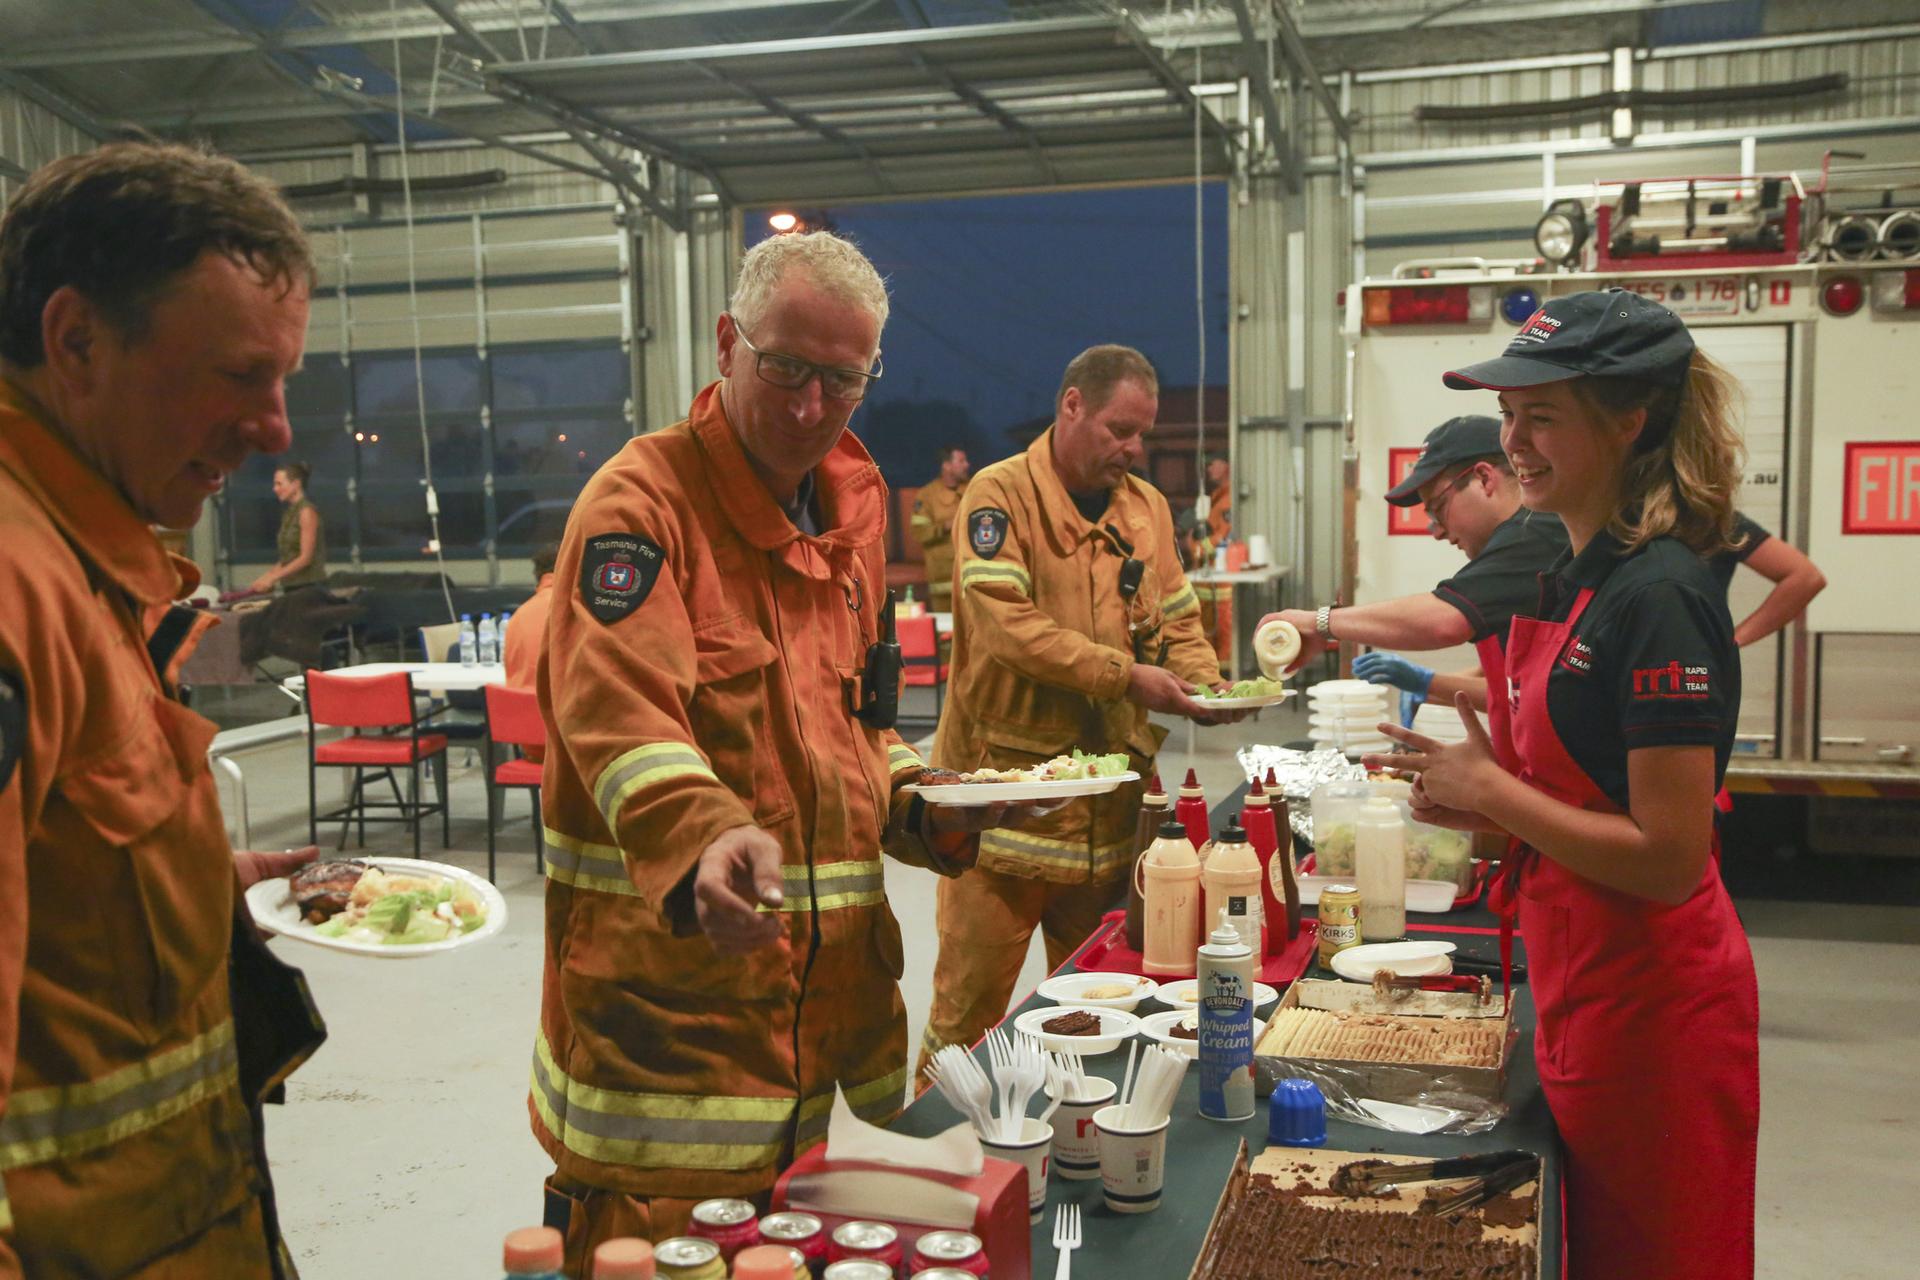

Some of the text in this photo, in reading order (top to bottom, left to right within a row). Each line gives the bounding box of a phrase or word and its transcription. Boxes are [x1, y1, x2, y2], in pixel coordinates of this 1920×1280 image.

[1694, 280, 1736, 302] 178
[1539, 315, 1562, 328] RAPID
[1530, 327, 1551, 339] TEAM
[593, 540, 656, 560] Tasmania Fire
[594, 596, 629, 609] Service
[1685, 666, 1708, 675] RAPID
[1685, 682, 1709, 692] TEAM
[1322, 927, 1355, 939] KIRKS
[1205, 997, 1245, 1008] DEVONDALE
[1201, 1018, 1250, 1036] Whipped
[1201, 1031, 1250, 1049] Cream
